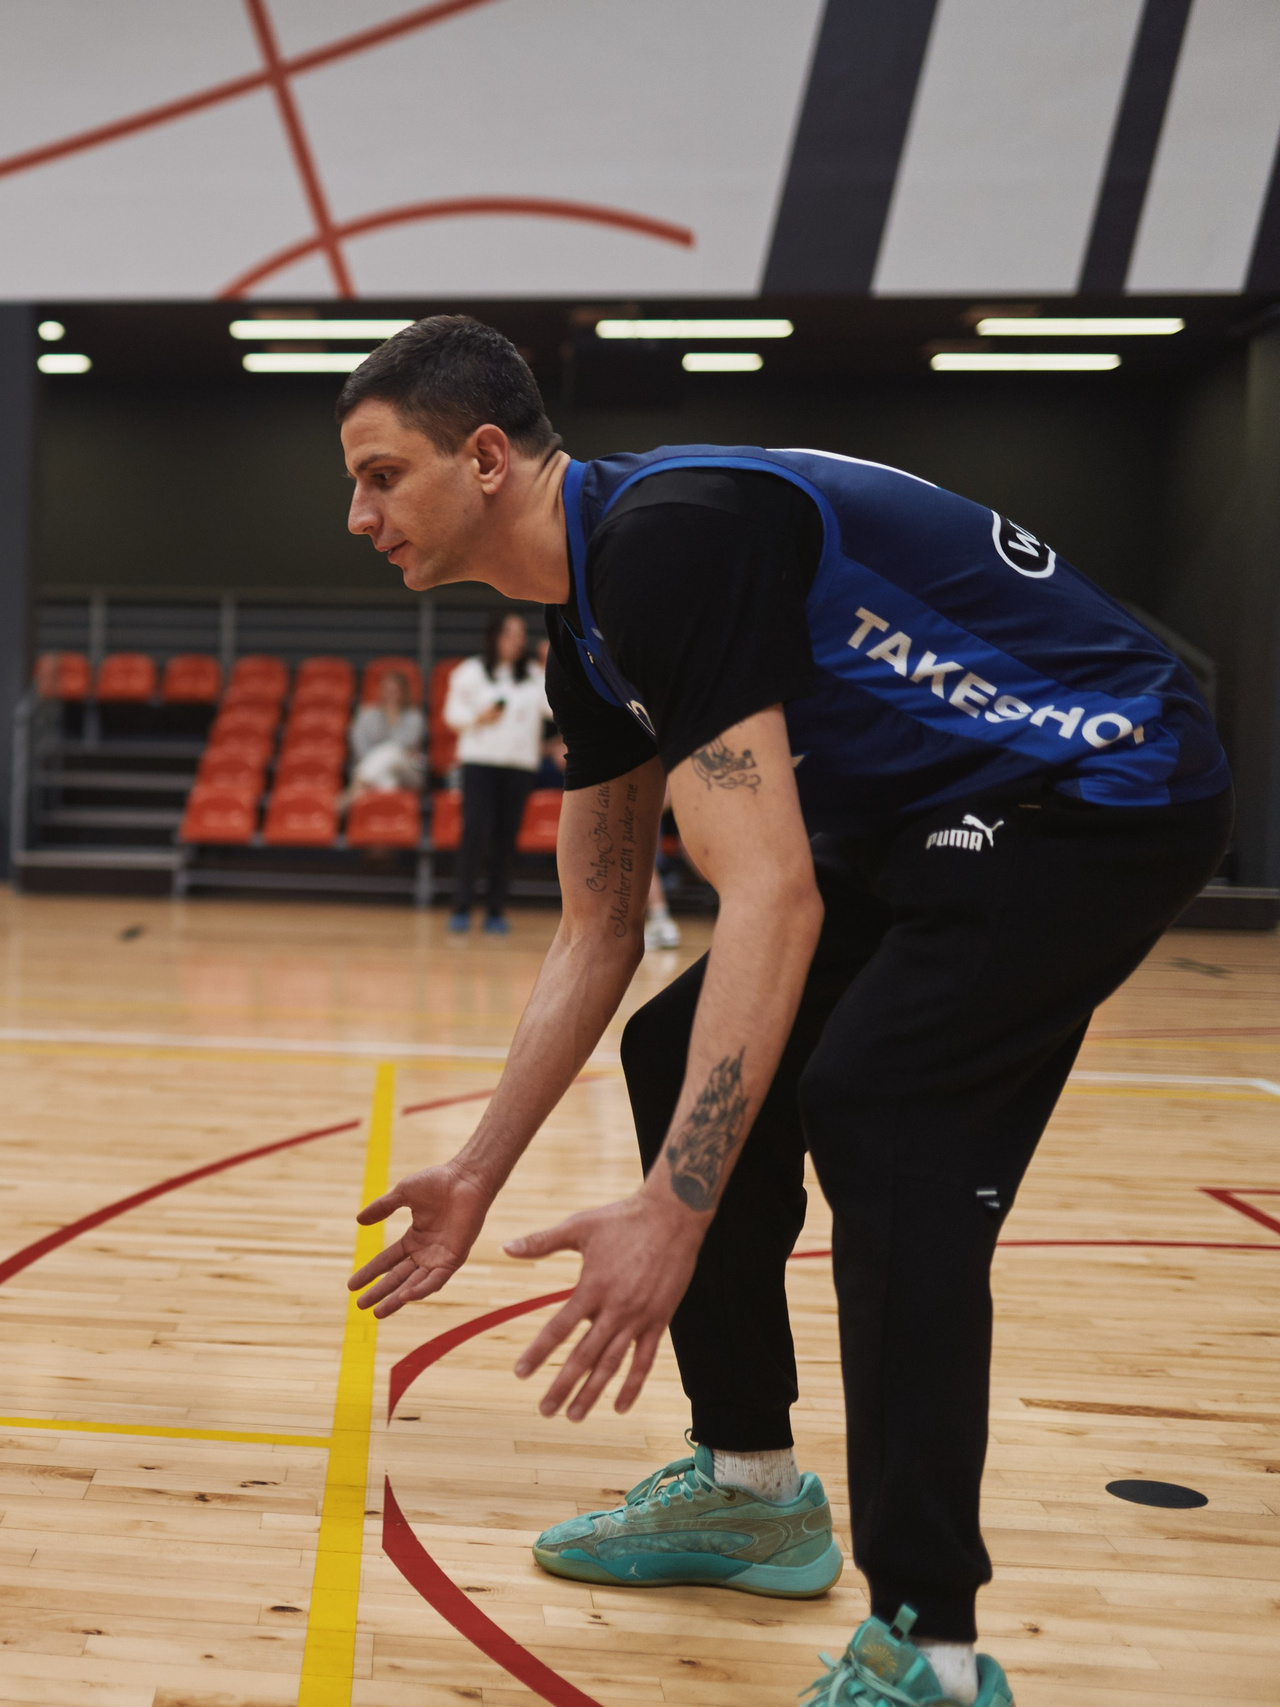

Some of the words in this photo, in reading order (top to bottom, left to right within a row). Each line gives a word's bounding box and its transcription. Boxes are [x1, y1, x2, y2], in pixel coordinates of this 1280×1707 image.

[627, 783, 638, 803] me
[925, 829, 984, 852] PUMA
[620, 848, 633, 872] can
[586, 853, 615, 892] Only
[610, 872, 632, 938] Mother
